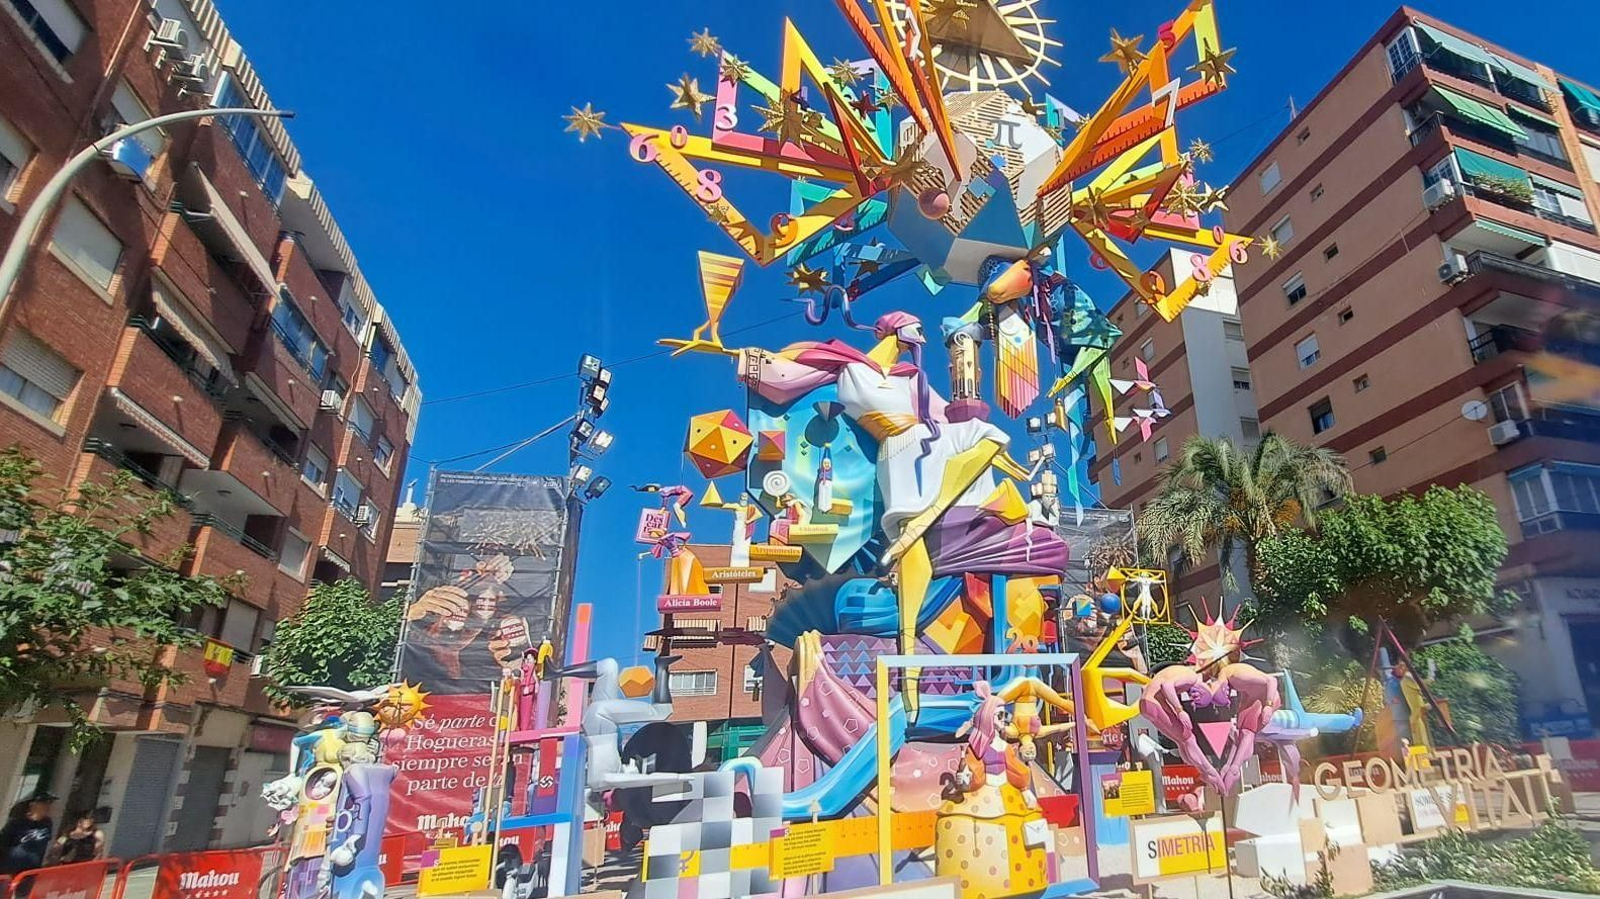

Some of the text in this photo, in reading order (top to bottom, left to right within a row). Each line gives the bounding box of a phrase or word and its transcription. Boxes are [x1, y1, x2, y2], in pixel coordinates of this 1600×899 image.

[1152, 77, 1180, 128] 7
[715, 104, 739, 130] 3
[629, 133, 660, 163] 6
[696, 168, 724, 203] 8
[1190, 253, 1212, 282] 8
[711, 568, 757, 578] Aristóteles
[664, 598, 718, 607] Alicia Boole
[412, 713, 436, 730] Sé
[437, 714, 485, 733] parte
[405, 734, 496, 753] Hogueras
[391, 755, 468, 774] siempre
[1314, 740, 1505, 800] GEOMETRÍA
[405, 776, 458, 796] parte
[462, 771, 487, 789] de
[1161, 775, 1194, 785] Mahou
[179, 869, 240, 890] Mahou
